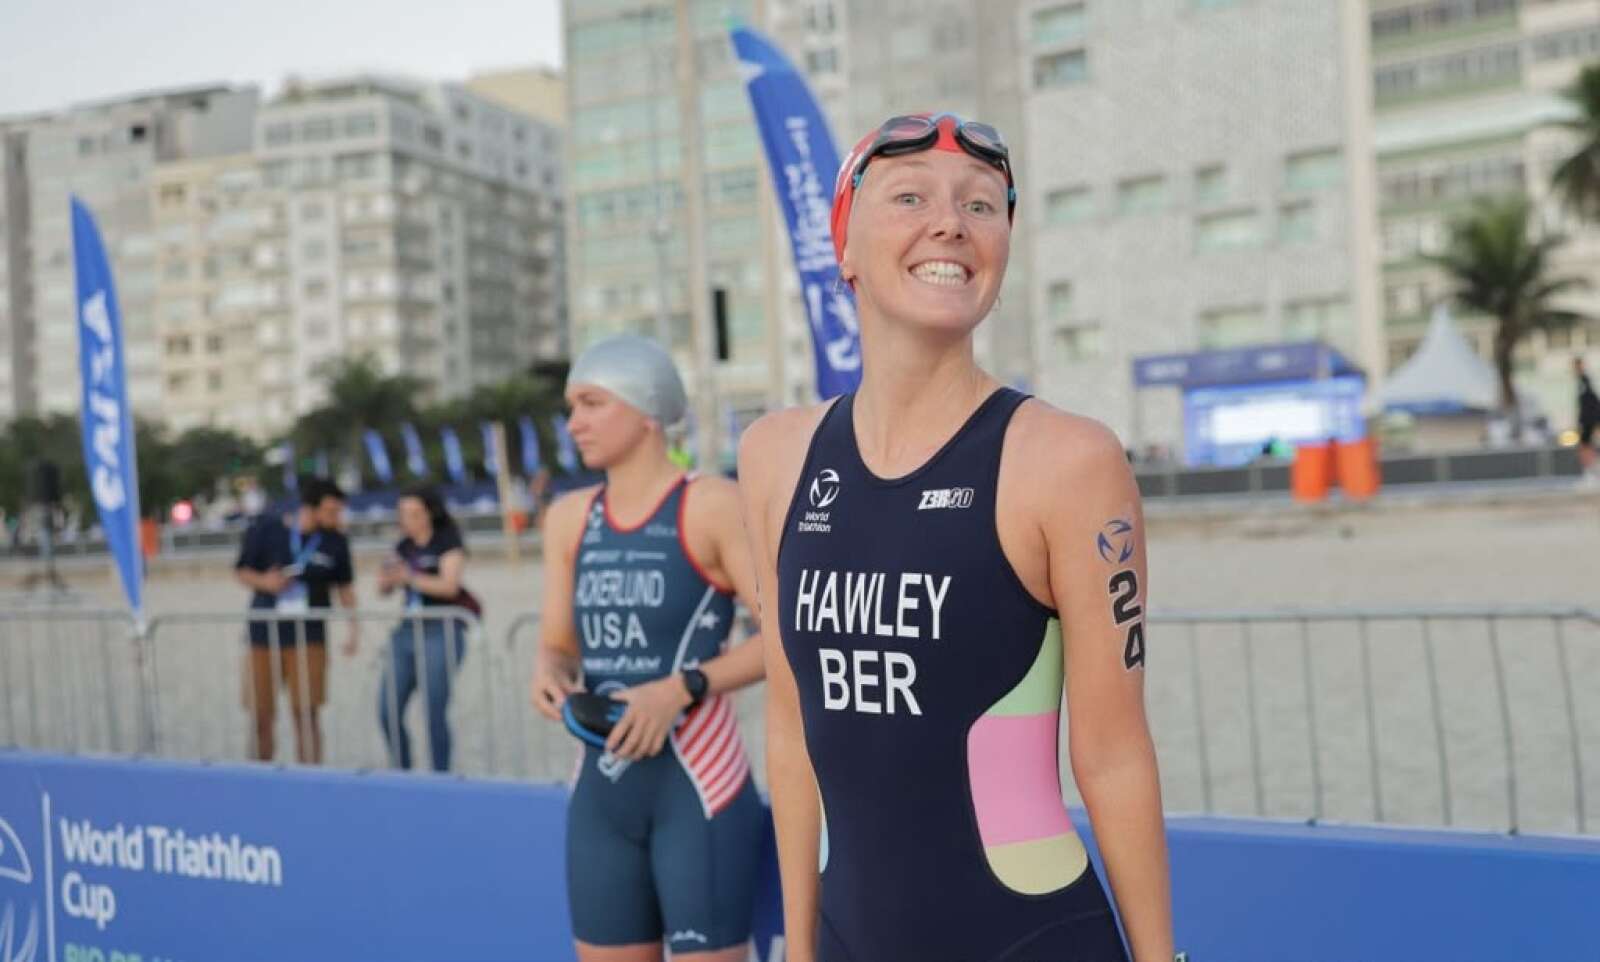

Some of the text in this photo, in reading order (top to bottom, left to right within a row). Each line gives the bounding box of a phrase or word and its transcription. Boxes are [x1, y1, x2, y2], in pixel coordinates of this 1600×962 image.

[582, 612, 648, 649] USA
[795, 569, 953, 640] HAWLEY
[819, 648, 923, 716] BER
[60, 817, 283, 887] World Triathlon
[61, 870, 116, 931] Cup
